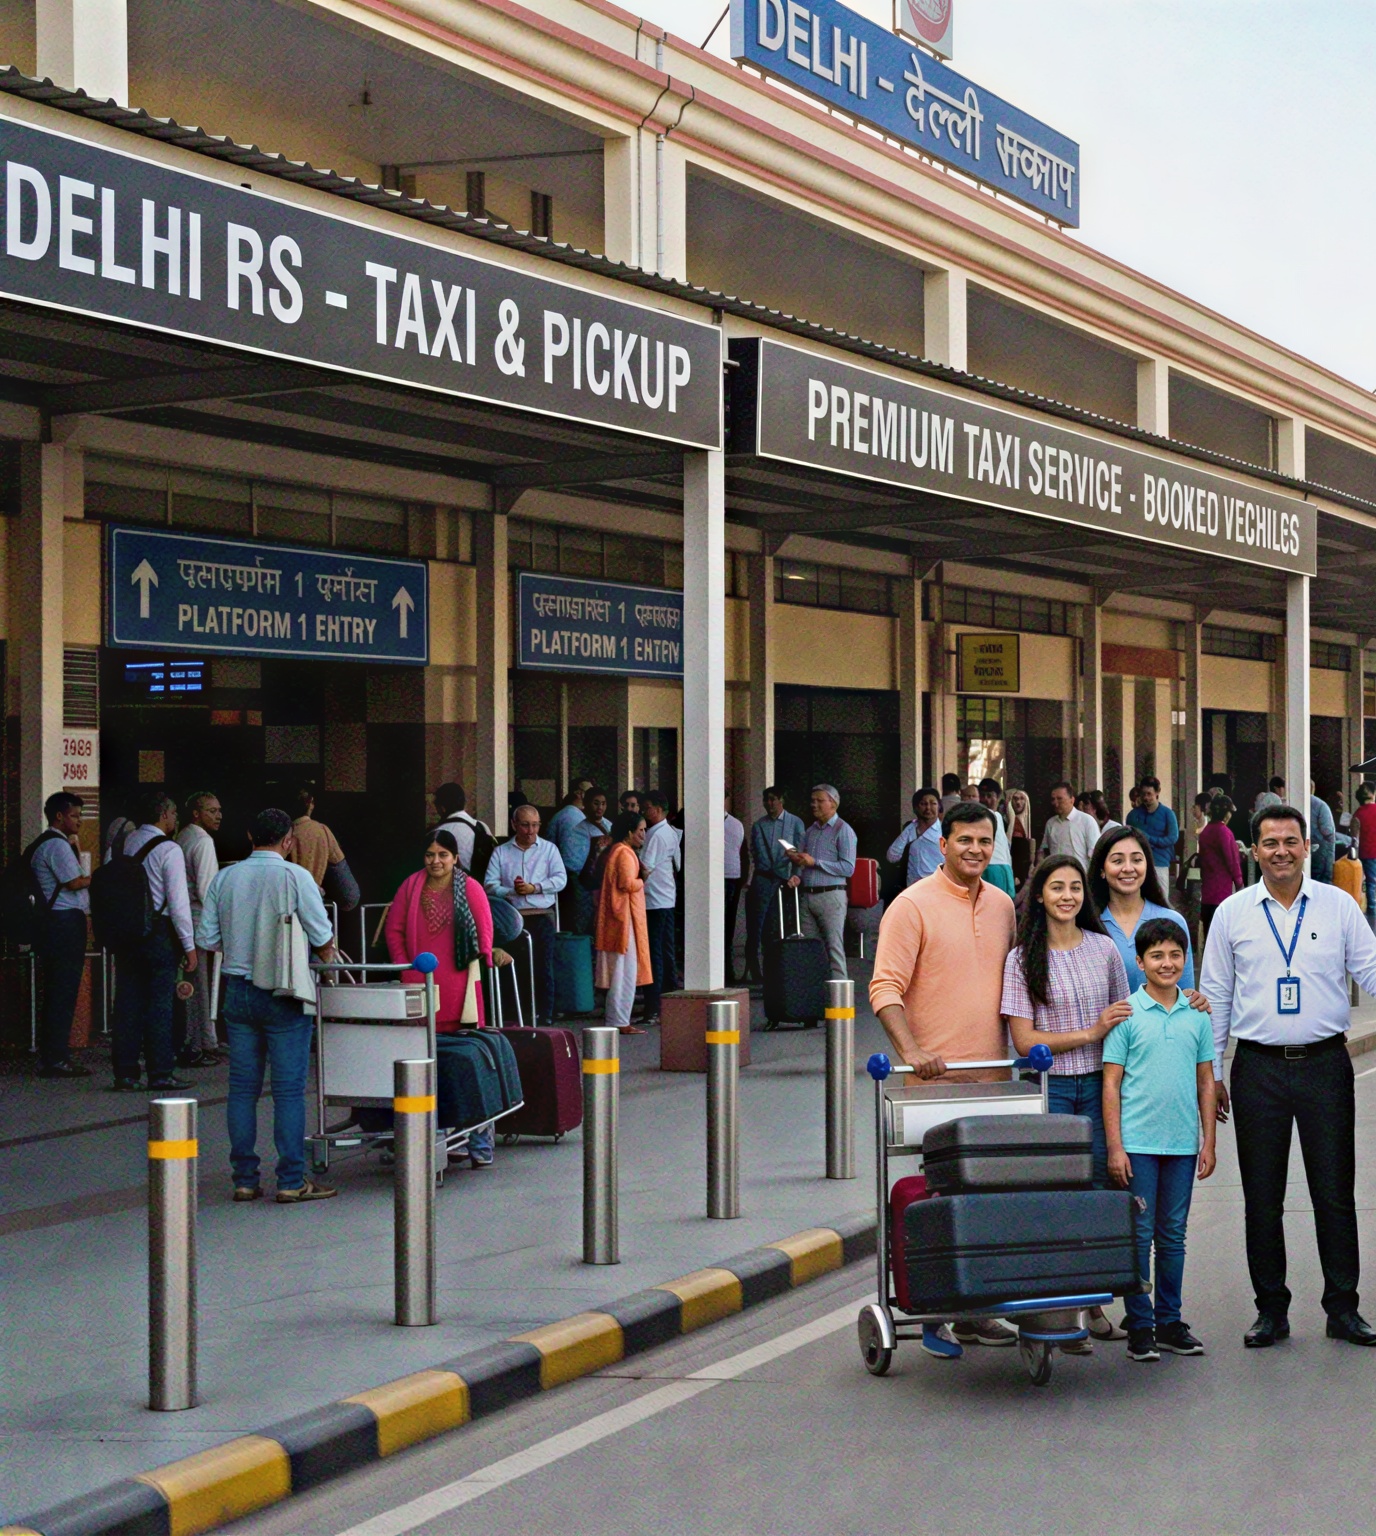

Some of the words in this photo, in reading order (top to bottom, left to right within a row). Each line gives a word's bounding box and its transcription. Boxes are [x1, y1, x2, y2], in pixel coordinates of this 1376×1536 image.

[757, 0, 868, 101] DELHI
[6, 160, 202, 301] DELHI
[227, 221, 304, 324] RS
[365, 260, 477, 367] TAXI
[494, 298, 526, 378] &
[543, 309, 692, 414] PICKUP
[808, 377, 955, 475] PREMIUM
[963, 422, 1021, 490] TAXI
[1028, 440, 1123, 515] SERVICE
[1143, 472, 1219, 537] BOOKED
[177, 603, 292, 640] PLATFORM
[297, 612, 307, 641] 1
[530, 627, 617, 660] PLATFORM
[620, 635, 628, 661] 1
